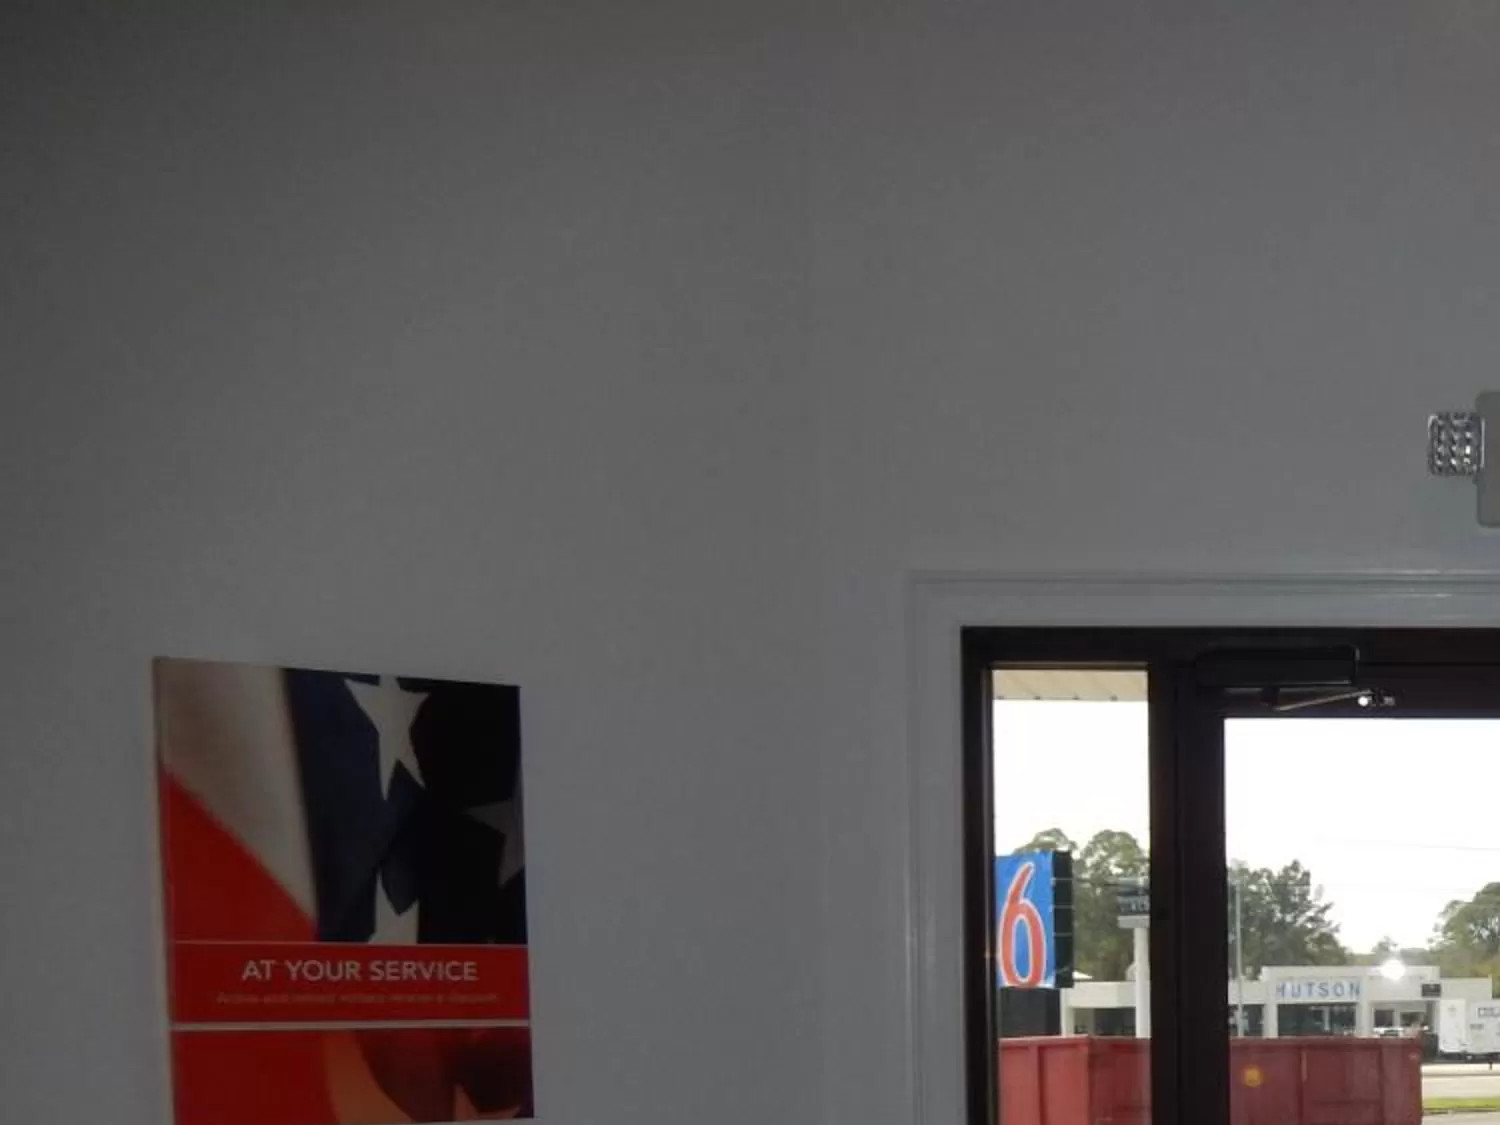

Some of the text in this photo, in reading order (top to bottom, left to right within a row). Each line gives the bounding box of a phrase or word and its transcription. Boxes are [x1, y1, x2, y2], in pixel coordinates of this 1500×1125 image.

[998, 860, 1048, 988] 6
[241, 959, 480, 982] AT YOUR SERVICE
[1275, 981, 1361, 998] HUTSON
